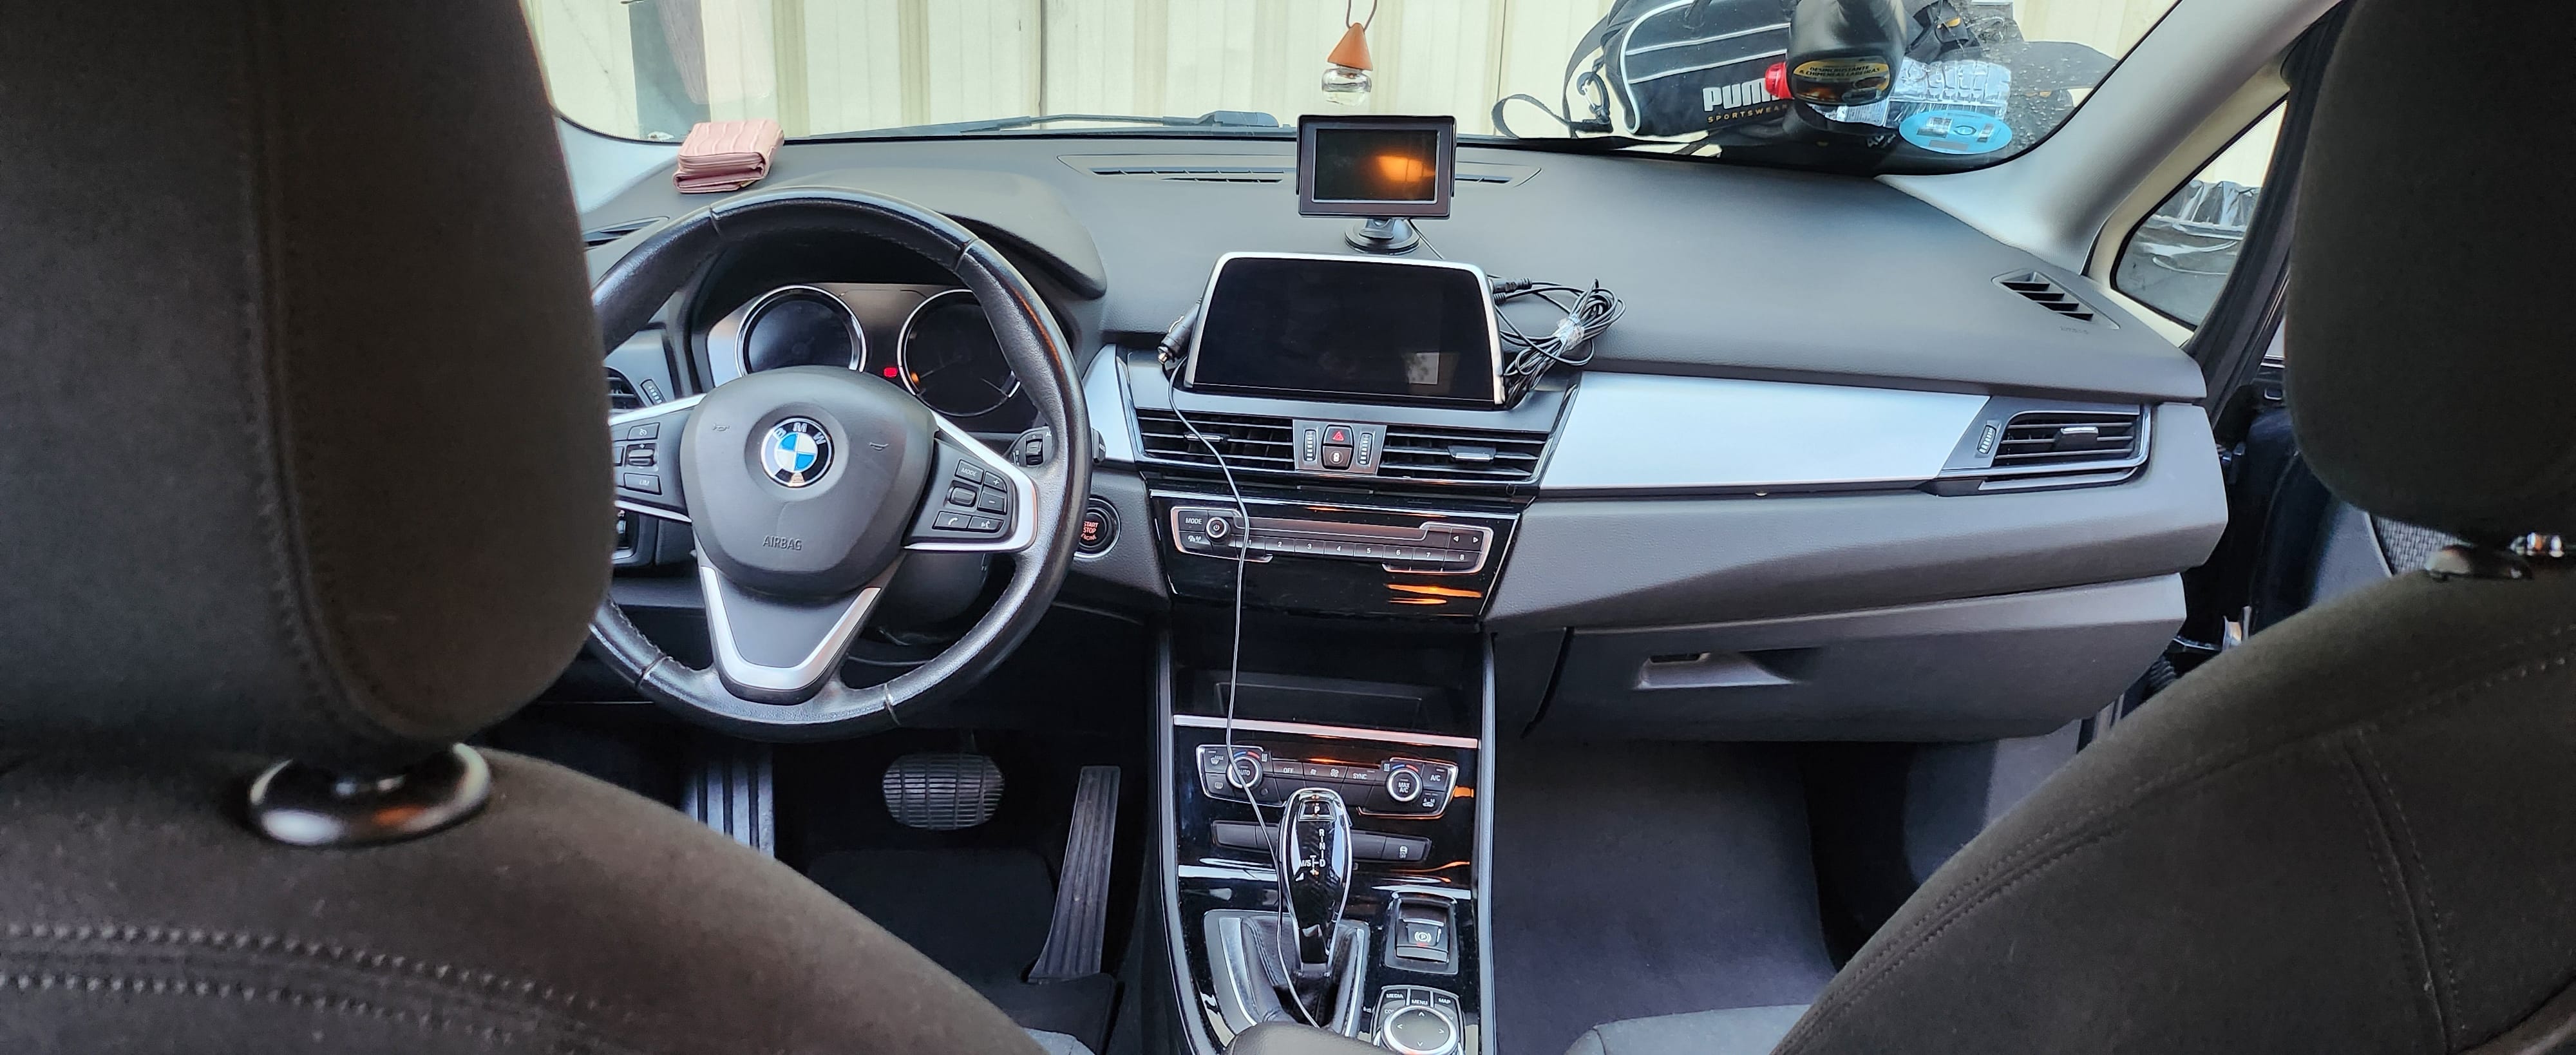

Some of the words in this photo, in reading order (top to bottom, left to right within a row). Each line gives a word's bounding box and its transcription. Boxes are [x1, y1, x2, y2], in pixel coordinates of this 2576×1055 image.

[1703, 78, 1780, 111] PUM
[1708, 104, 1788, 124] SPORTSWEAR
[773, 422, 827, 446] BMW
[961, 467, 977, 477] MODE
[762, 535, 803, 551] AIRBAG
[1319, 828, 1325, 837] R
[1319, 842, 1325, 850] N
[1319, 859, 1326, 868] D
